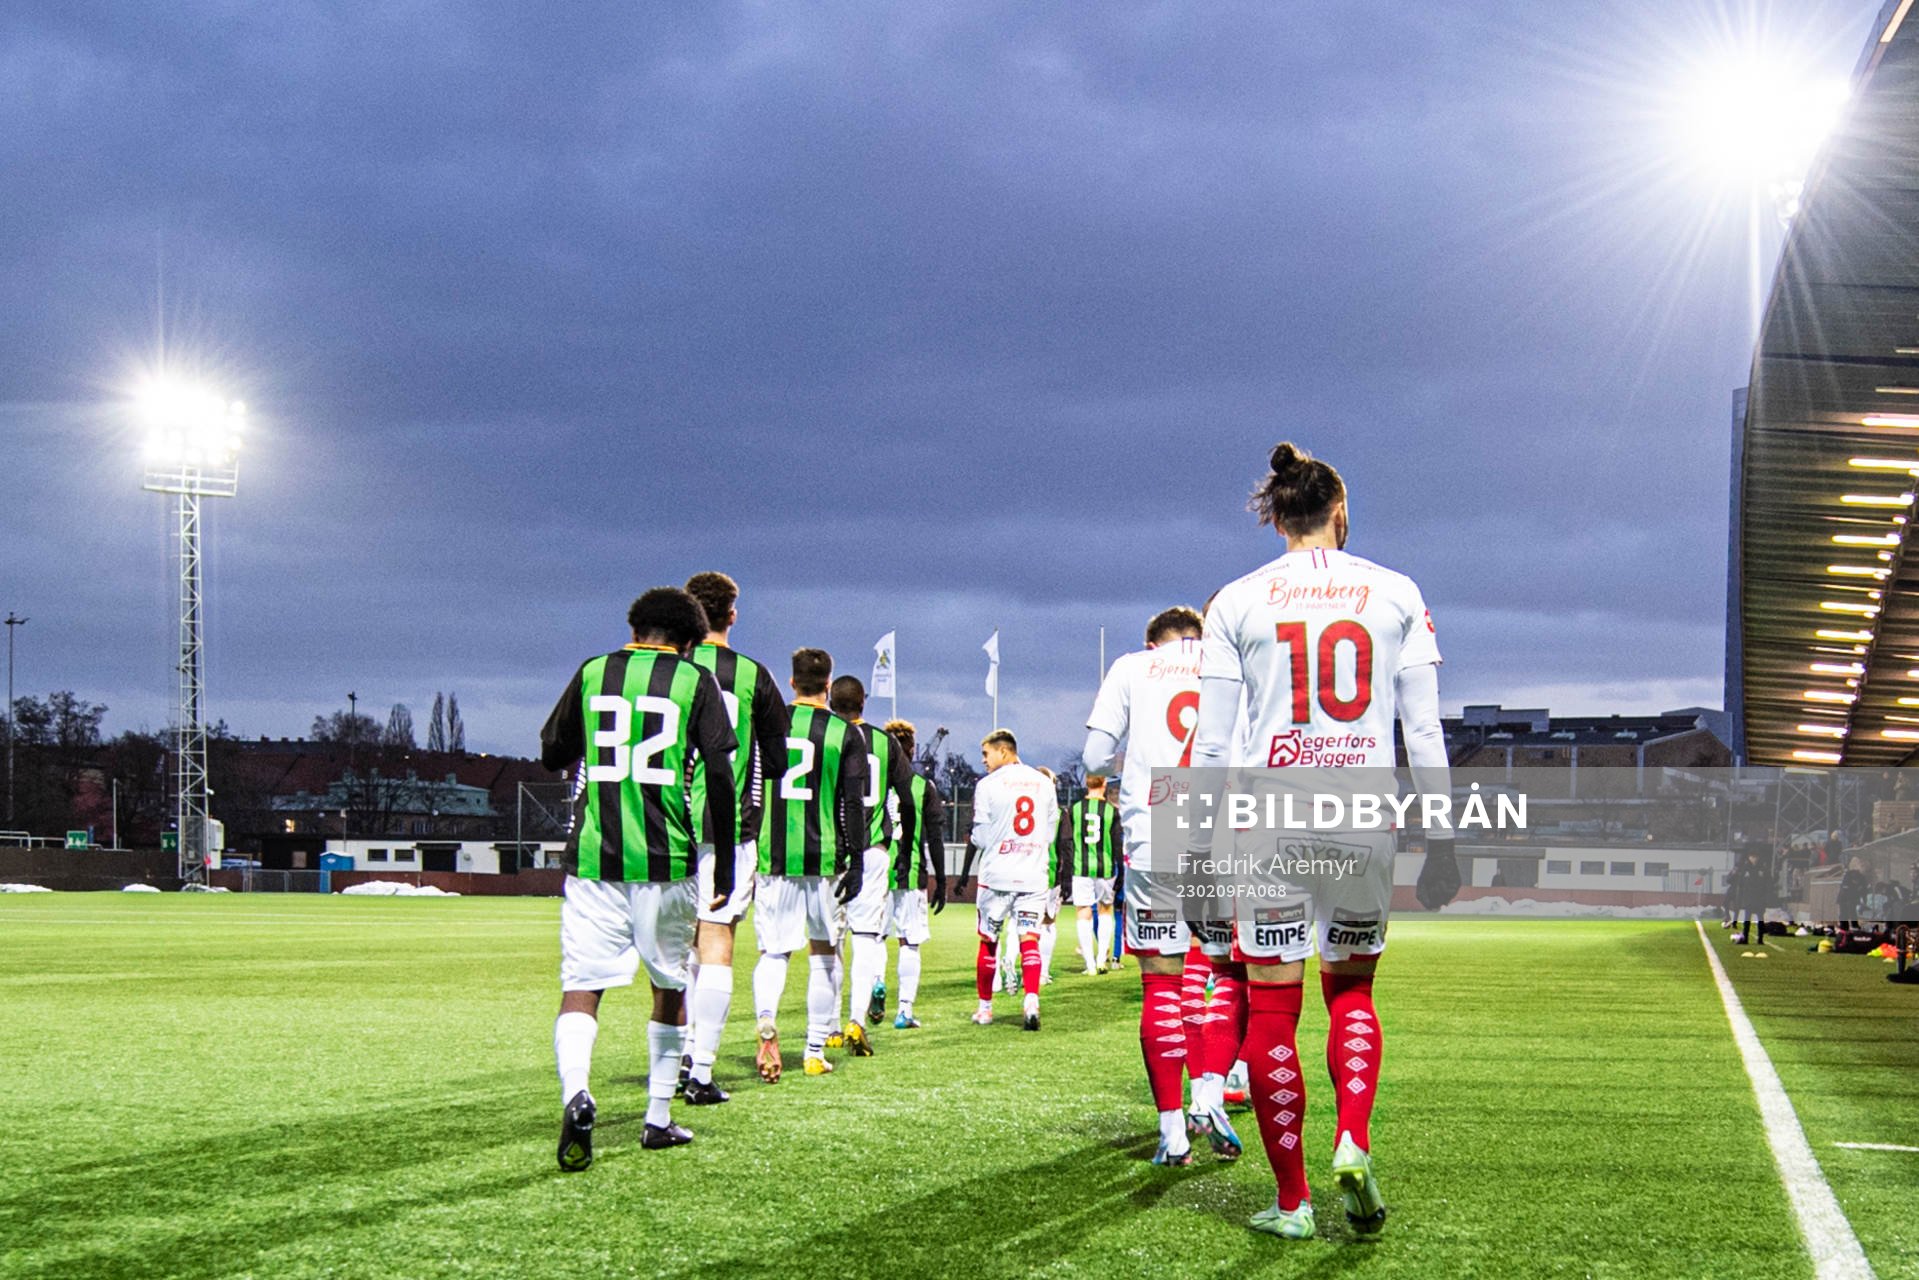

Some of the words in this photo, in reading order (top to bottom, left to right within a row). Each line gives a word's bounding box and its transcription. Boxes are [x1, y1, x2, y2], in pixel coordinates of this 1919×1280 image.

[1275, 620, 1374, 725] 10
[587, 695, 681, 786] 32
[780, 737, 815, 800] 2
[1300, 750, 1366, 768] Byggen
[1013, 796, 1035, 836] 8
[1084, 813, 1101, 844] 3
[1138, 925, 1177, 940] EMPE
[1255, 924, 1306, 946] EMPE
[1327, 927, 1378, 946] EMPE
